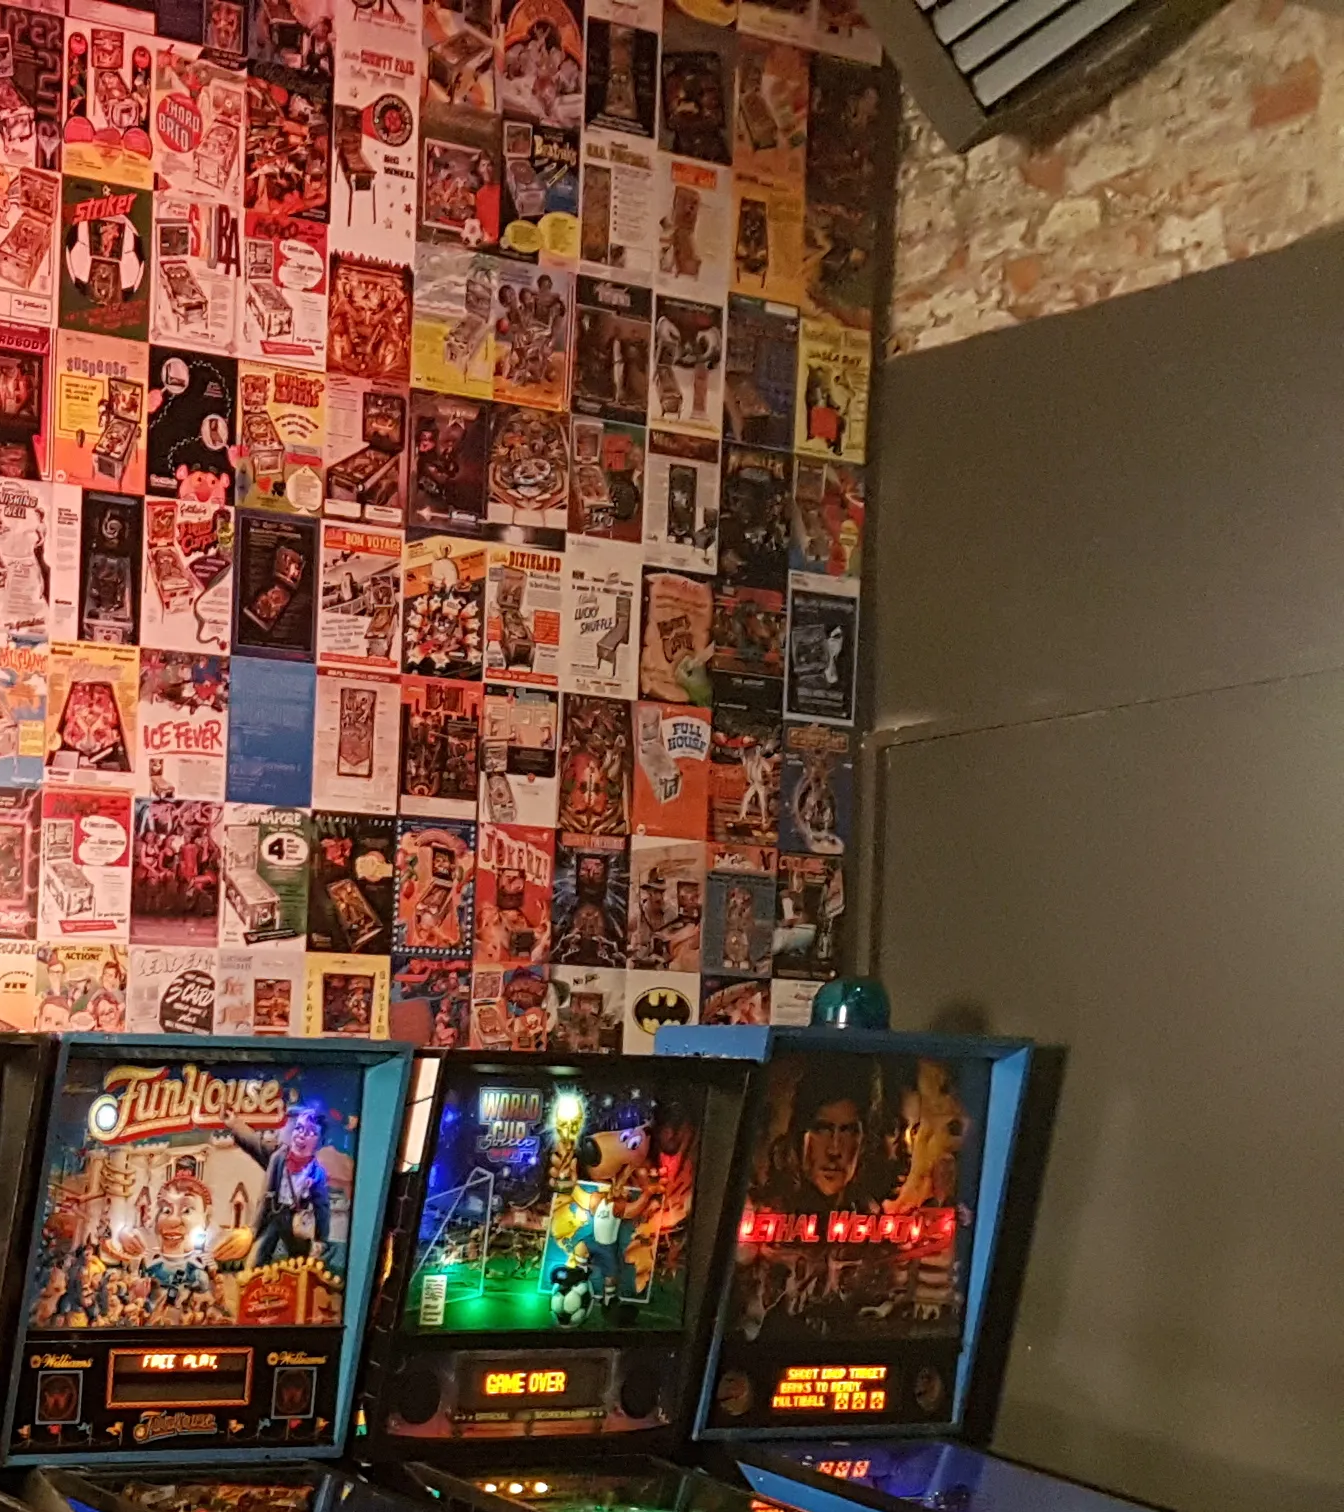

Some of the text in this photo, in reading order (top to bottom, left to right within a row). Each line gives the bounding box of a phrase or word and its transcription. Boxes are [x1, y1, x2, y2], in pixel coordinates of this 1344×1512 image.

[66, 356, 128, 380] suspense
[345, 534, 402, 550] BON VOYAGE
[574, 605, 599, 622] LUCKY
[143, 719, 224, 750] ICE FEVER
[671, 722, 703, 737] FULL
[667, 734, 708, 752] HOUSE
[238, 808, 302, 828] SINGAPORE
[267, 837, 286, 861] 4
[91, 1064, 286, 1143] FunHouse
[482, 1092, 540, 1120] WORLD
[492, 1120, 526, 1140] CUP
[739, 1210, 921, 1243] LETHAL WEAPON
[40, 1355, 93, 1370] Williams
[142, 1354, 176, 1369] FREE
[277, 1352, 328, 1366] Williams
[849, 1367, 887, 1379] TARGET
[485, 1371, 566, 1395] GAME OVER
[772, 1395, 826, 1408] MULTIBALL
